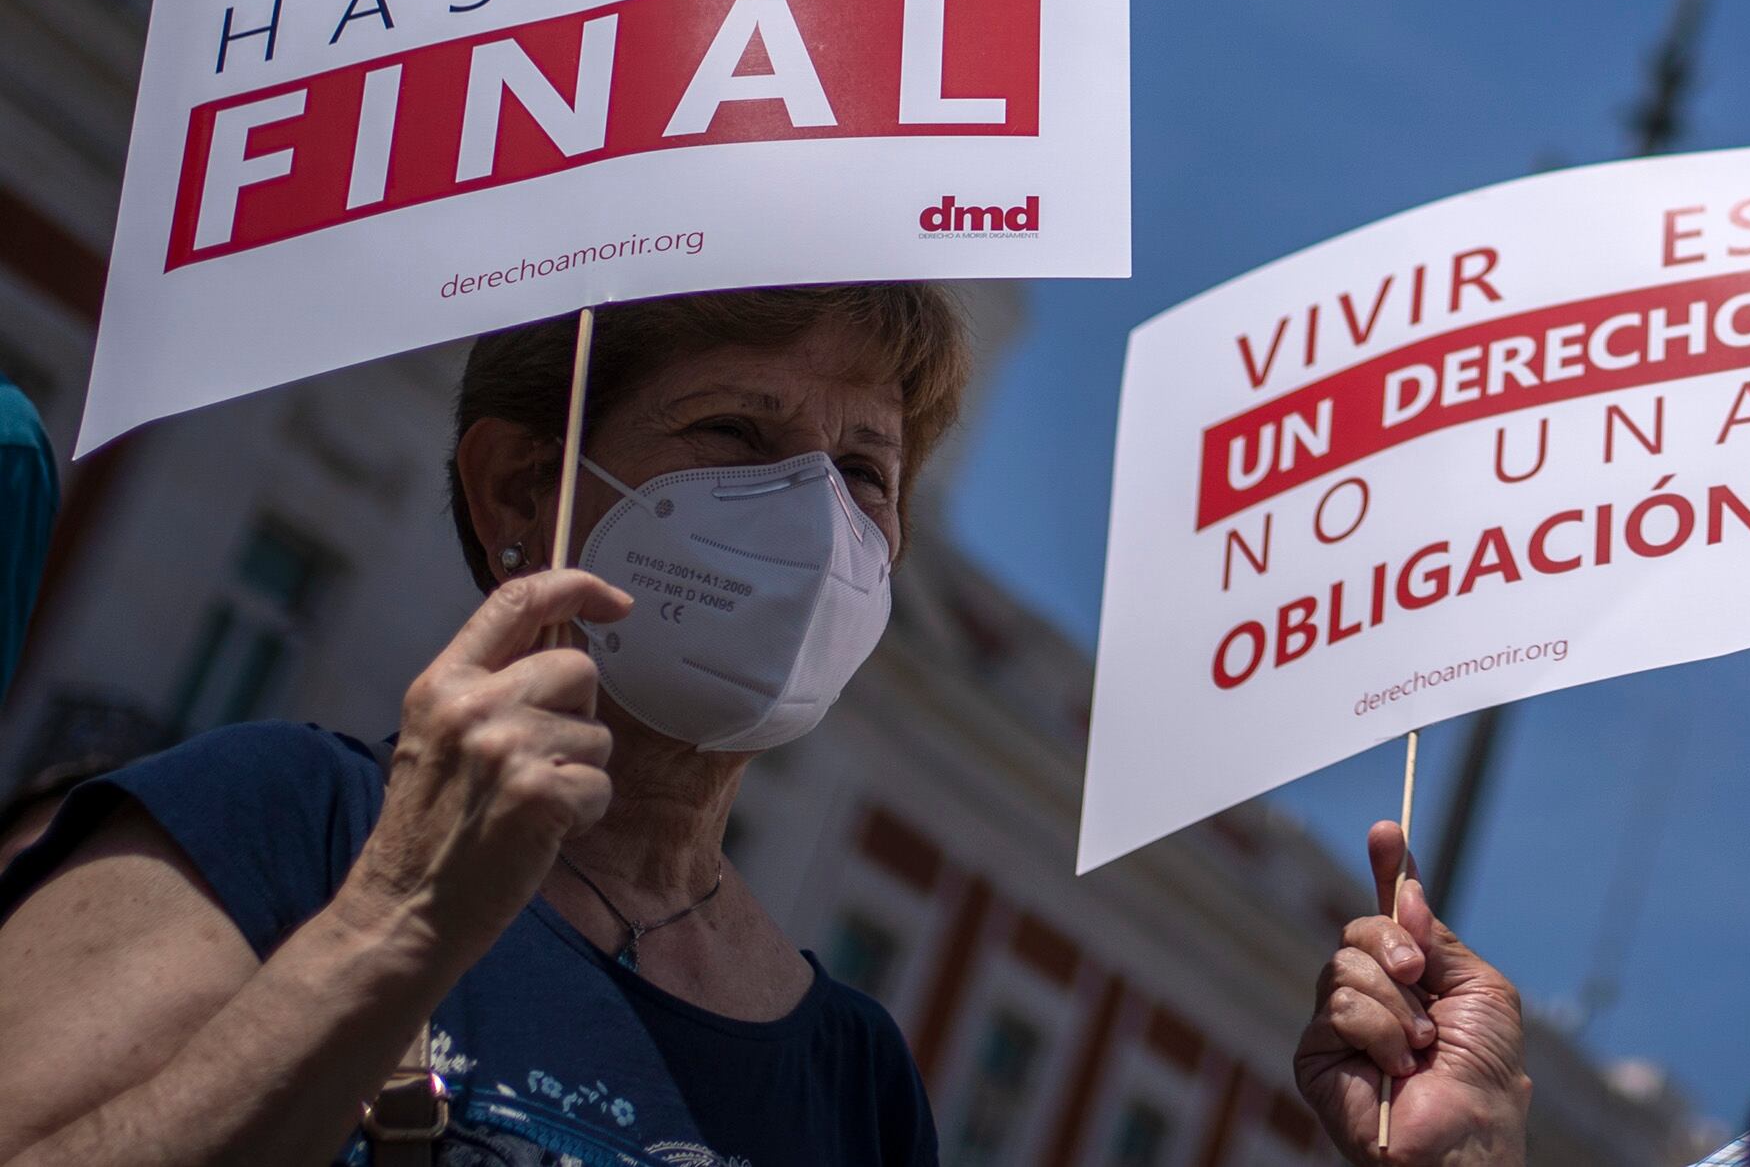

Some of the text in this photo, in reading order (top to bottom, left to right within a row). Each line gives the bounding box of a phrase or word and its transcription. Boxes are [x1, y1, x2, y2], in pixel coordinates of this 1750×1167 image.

[919, 195, 1040, 232] dmd
[440, 231, 704, 299] derechoamorir.org
[1235, 246, 1505, 391] VIVIR
[1226, 398, 1334, 493] UN
[1221, 476, 1371, 592] NO
[631, 573, 736, 613] FFP2 NR D KN95
[1353, 639, 1569, 717] derechoamorir.org
